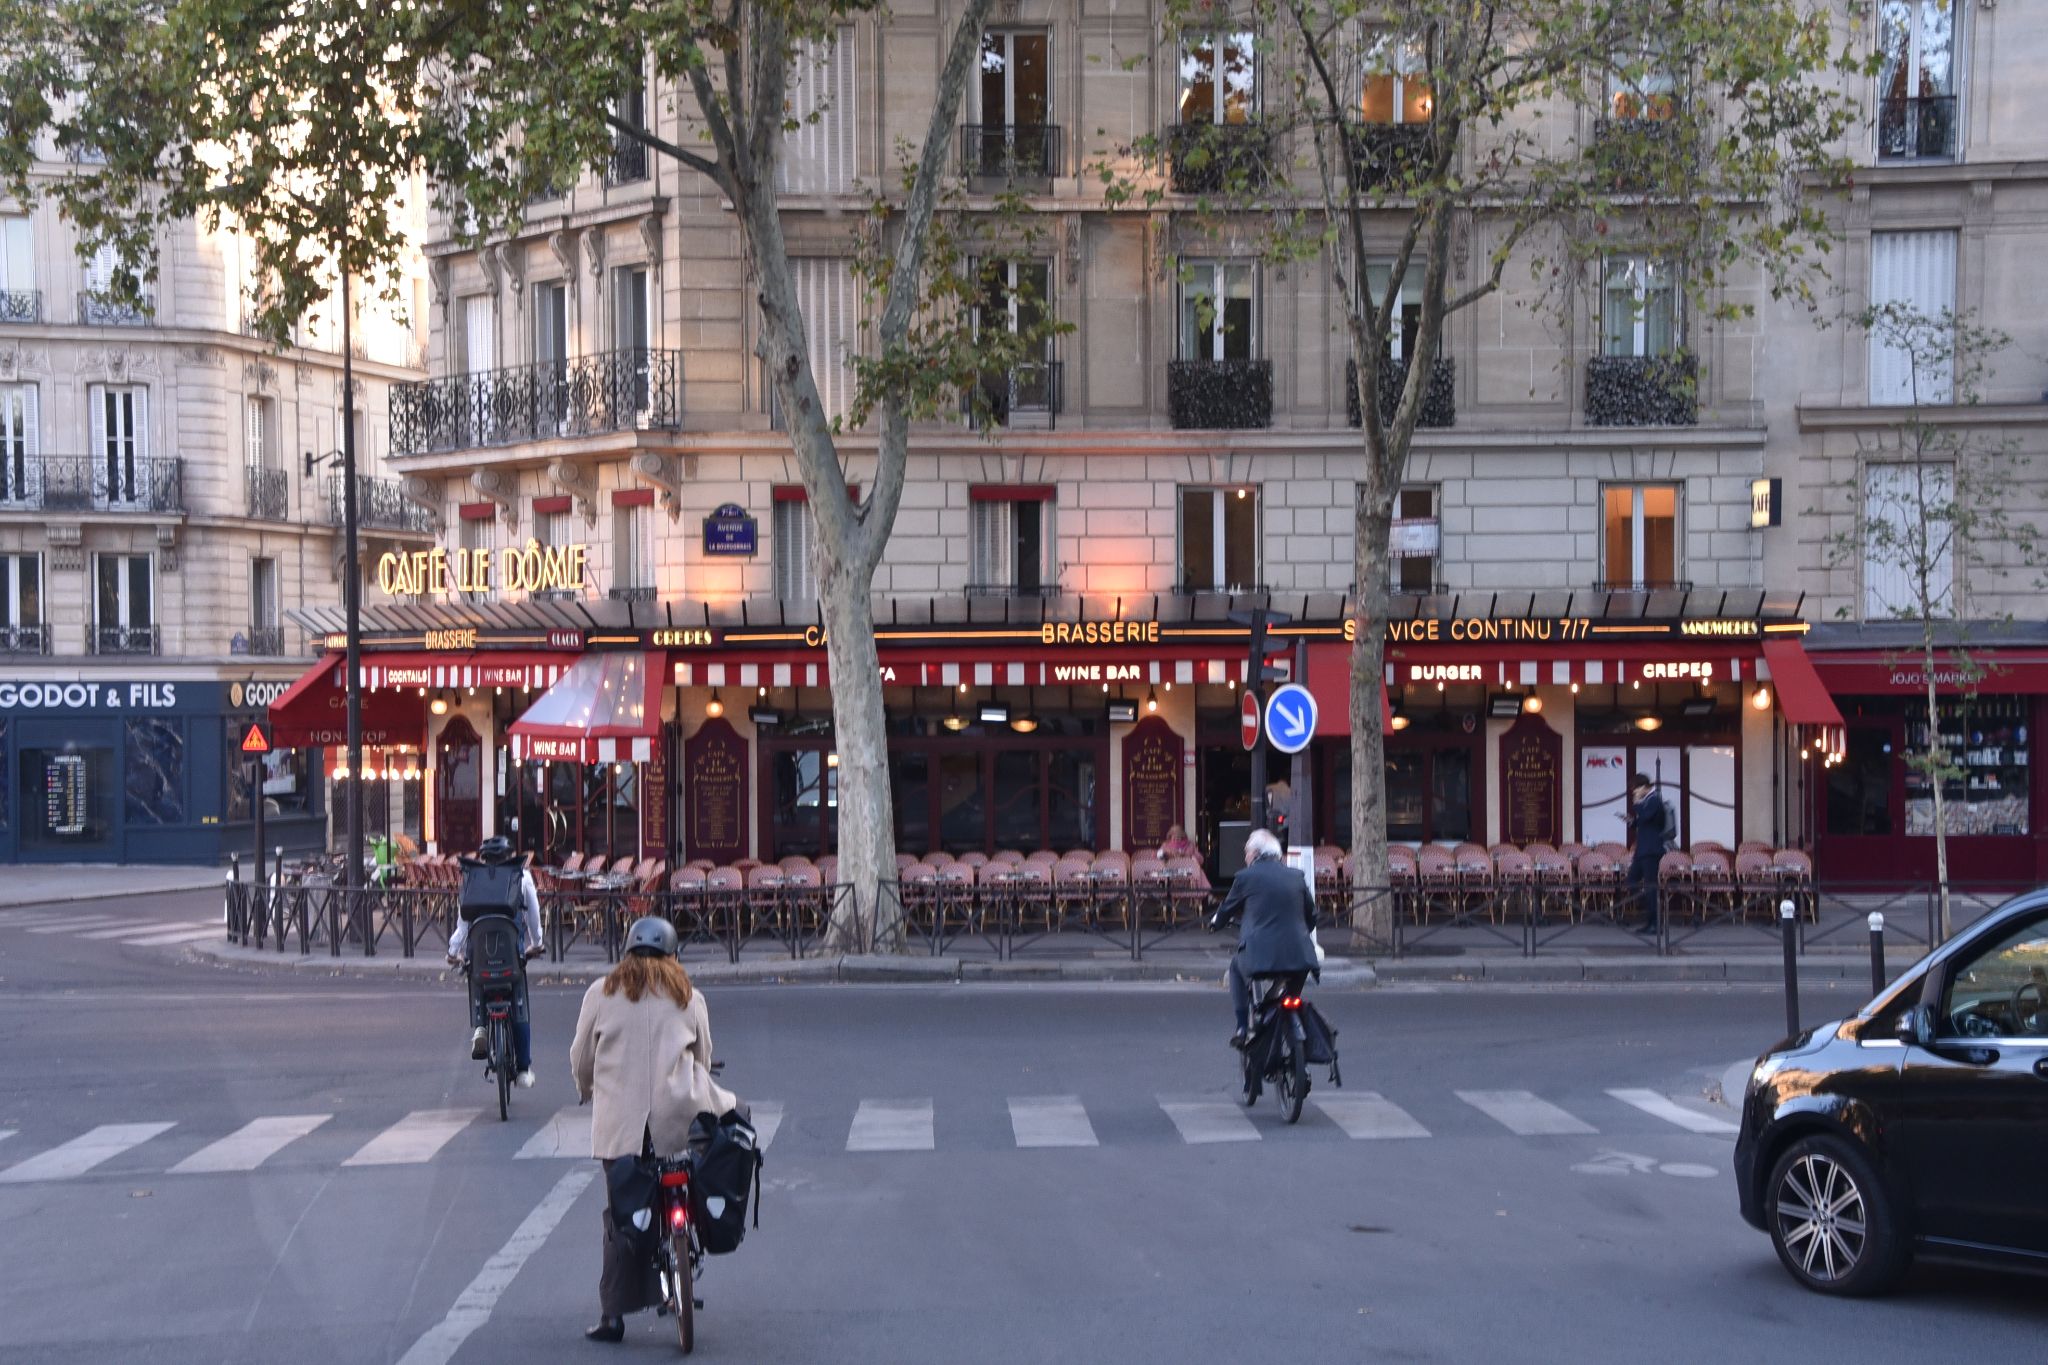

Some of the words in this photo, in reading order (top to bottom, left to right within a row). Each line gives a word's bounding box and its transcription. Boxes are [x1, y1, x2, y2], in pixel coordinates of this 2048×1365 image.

[717, 523, 743, 532] AVENUE
[378, 546, 448, 595] CAFÉ
[457, 547, 490, 592] LE
[502, 537, 587, 592] DÔME
[1041, 621, 1159, 644] BRASSERIE
[1344, 618, 1440, 641] SVICE
[1451, 618, 1551, 641] CONTINU
[1559, 618, 1590, 640] 7/7
[1680, 620, 1758, 635] SANDWICHES
[425, 628, 477, 650] BRASSERIE
[652, 630, 712, 646] CREPES
[388, 669, 427, 683] COCKTAILS
[484, 669, 503, 682] WINE
[505, 669, 522, 682] BAR
[1055, 665, 1101, 681] WINE
[1106, 665, 1141, 680] BAR
[1410, 665, 1482, 681] BURGER
[1643, 662, 1713, 678] CREPES
[0, 682, 100, 709] GODOT
[106, 688, 121, 708] &
[129, 682, 176, 708] FILS
[329, 696, 369, 709] CAE
[534, 741, 557, 756] WINE
[559, 742, 576, 756] BAR
